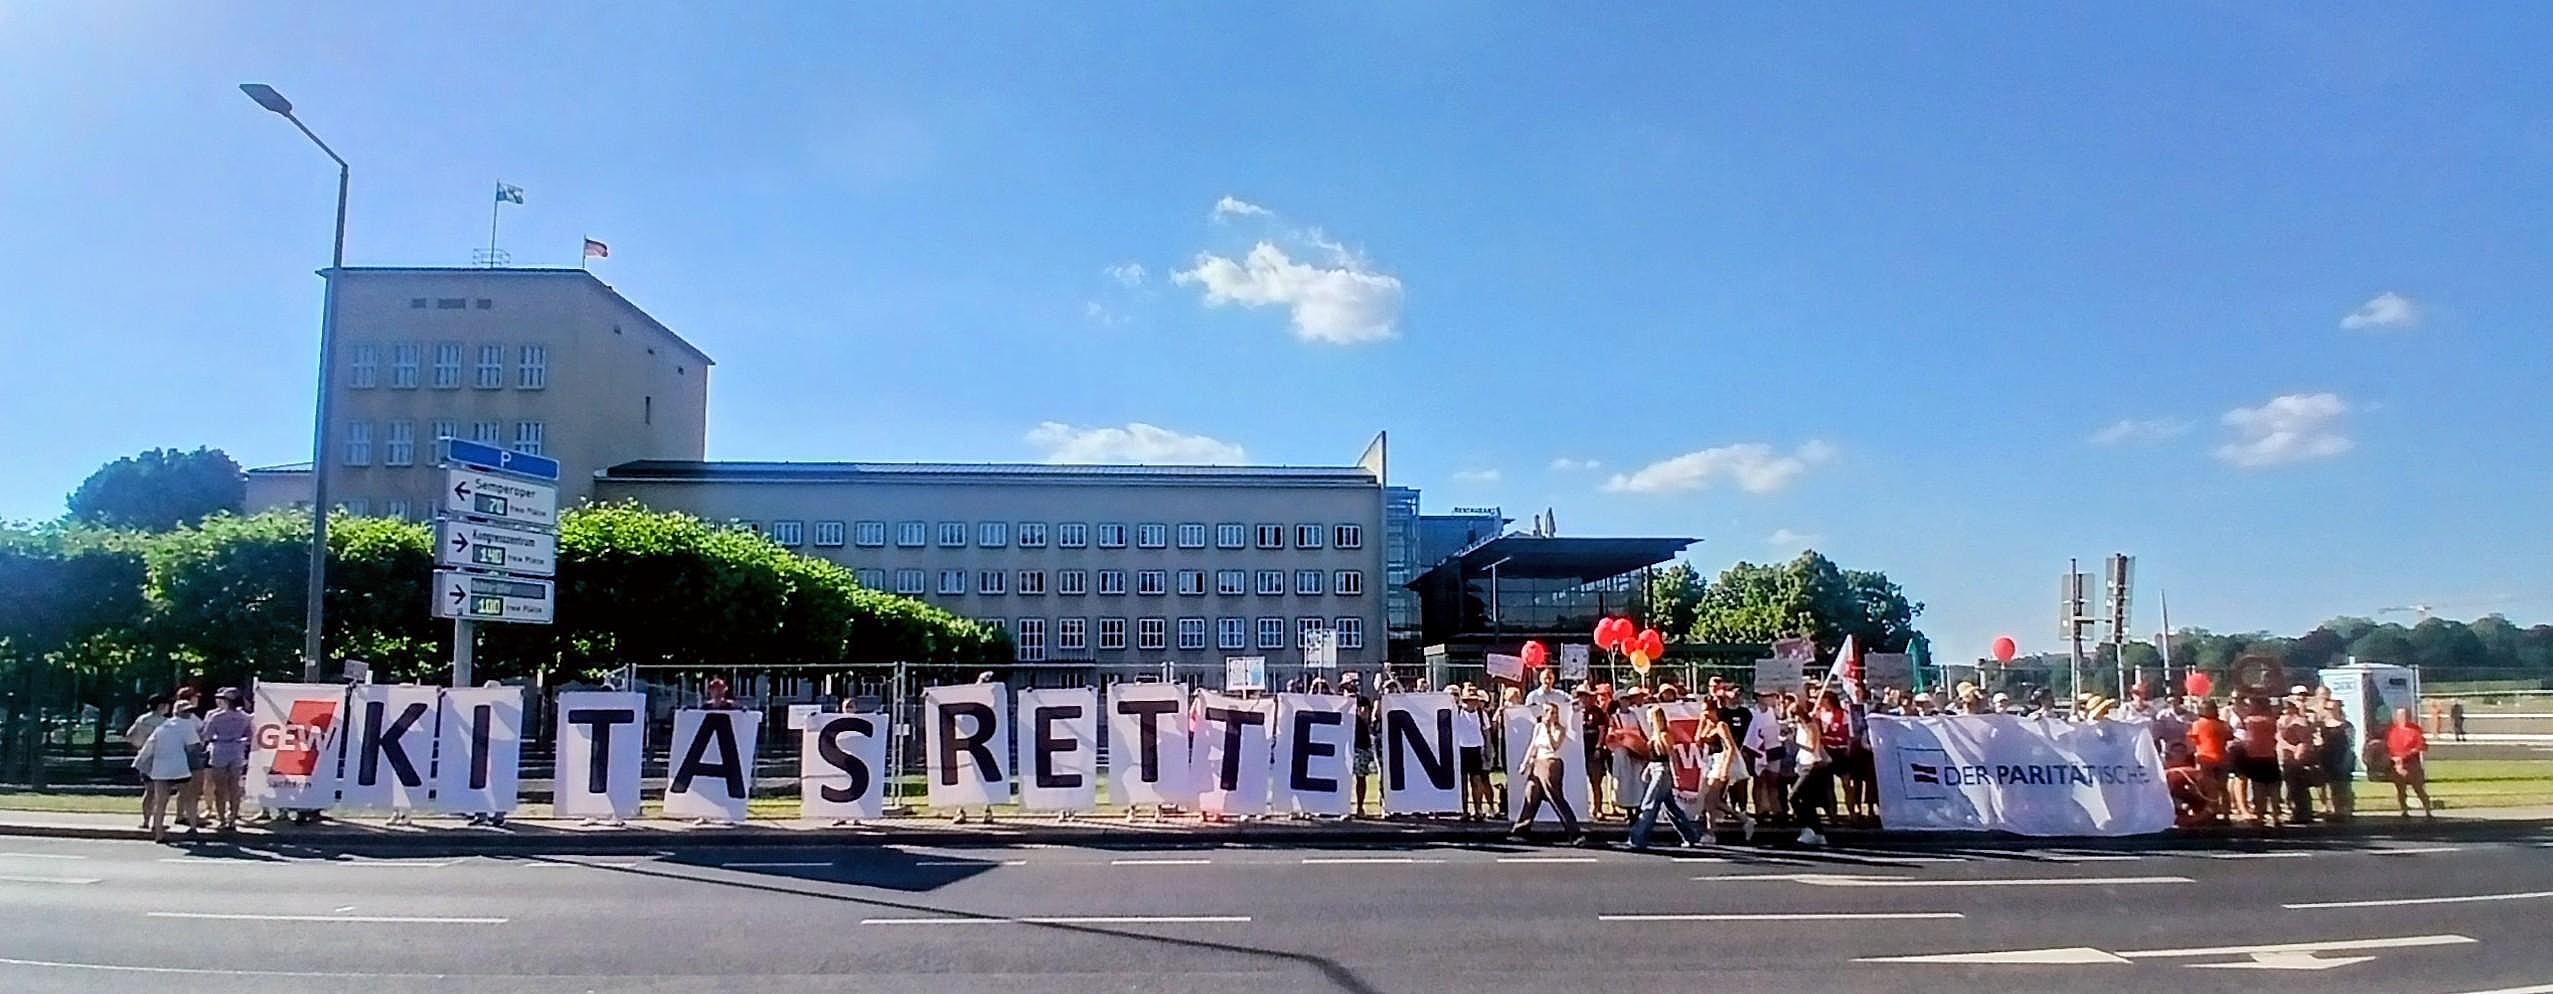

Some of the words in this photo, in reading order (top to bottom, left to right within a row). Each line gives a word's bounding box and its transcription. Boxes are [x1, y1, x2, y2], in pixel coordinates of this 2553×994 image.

[501, 451, 512, 467] P
[475, 478, 536, 498] Semperoper
[489, 498, 504, 514] 70
[478, 598, 501, 614] 100
[257, 723, 337, 751] GEW
[1943, 764, 1992, 786] DER
[1996, 762, 2150, 787] PARITÄTISCHE
